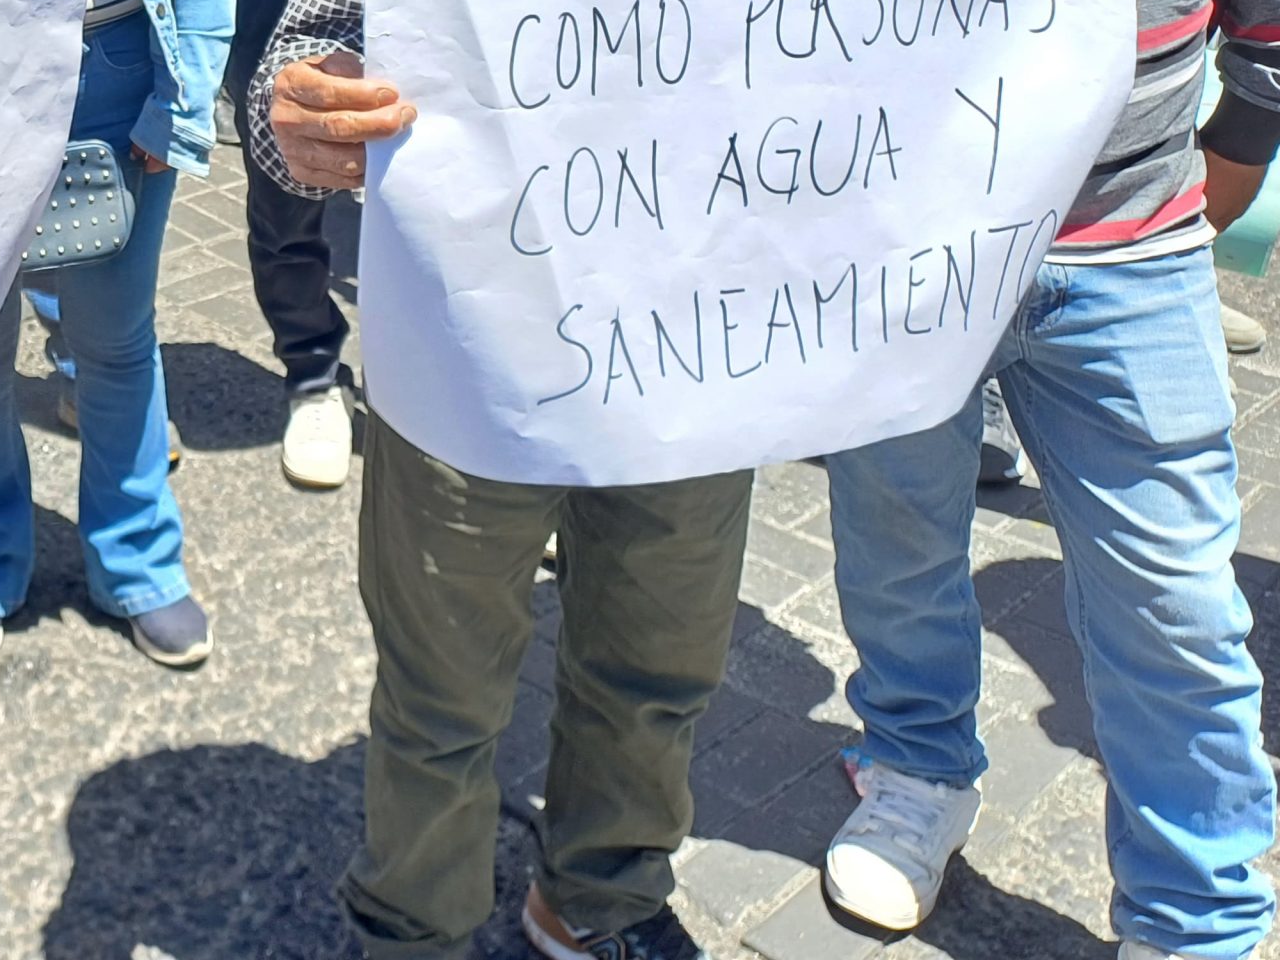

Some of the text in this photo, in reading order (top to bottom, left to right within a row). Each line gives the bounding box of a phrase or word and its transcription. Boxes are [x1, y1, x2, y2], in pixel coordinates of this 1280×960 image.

[510, 76, 1004, 256] CON AGUA Y
